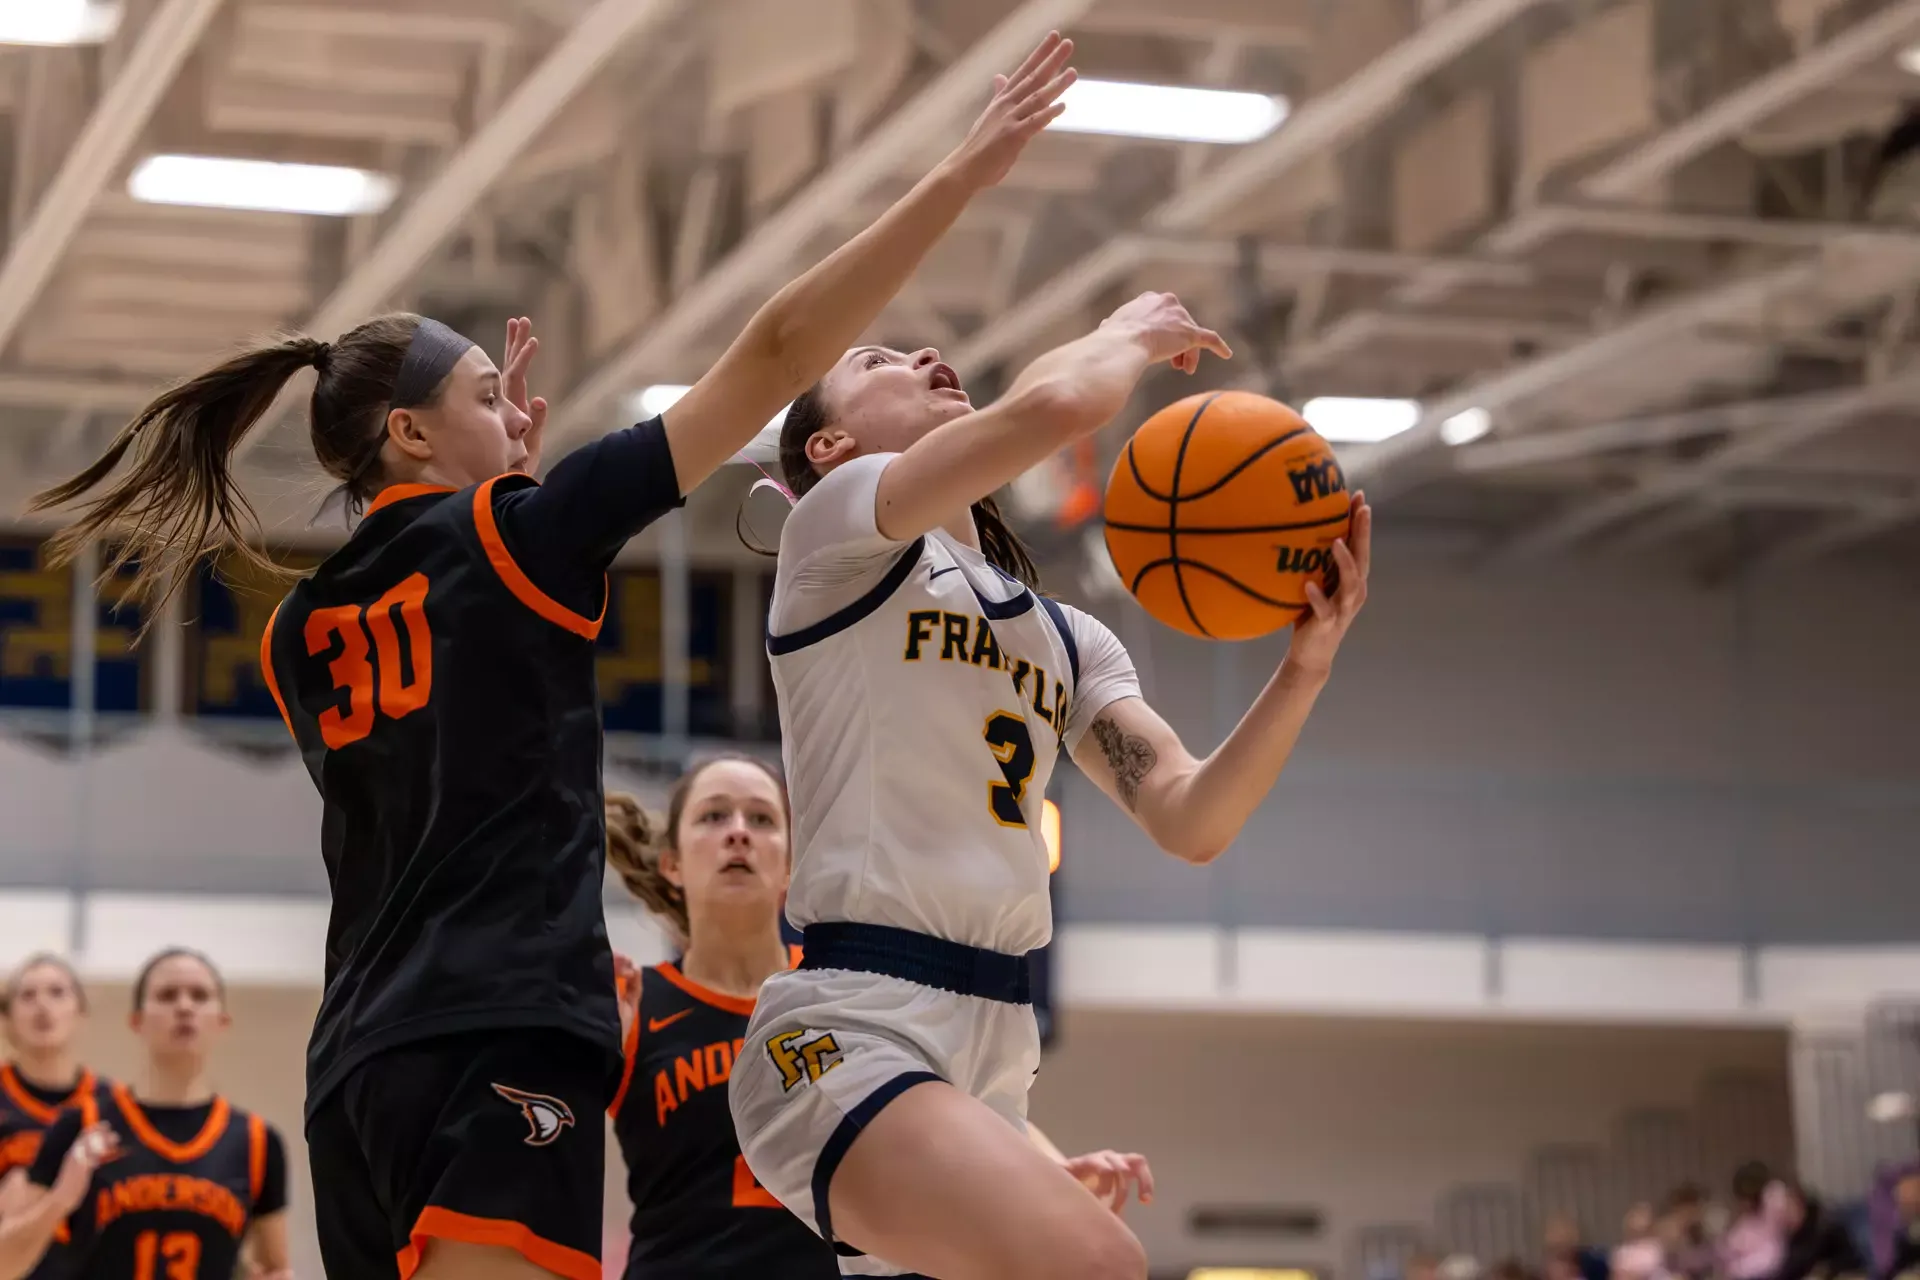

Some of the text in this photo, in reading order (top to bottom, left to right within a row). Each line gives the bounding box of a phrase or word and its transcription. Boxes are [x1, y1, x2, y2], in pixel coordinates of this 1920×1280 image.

[1287, 458, 1346, 504] CAA
[304, 571, 432, 751] 30
[903, 609, 1068, 750] FRAKLI
[982, 709, 1037, 830] 3
[765, 1029, 845, 1093] FC
[96, 1173, 246, 1238] ANDERSON
[134, 1229, 202, 1280] 13
